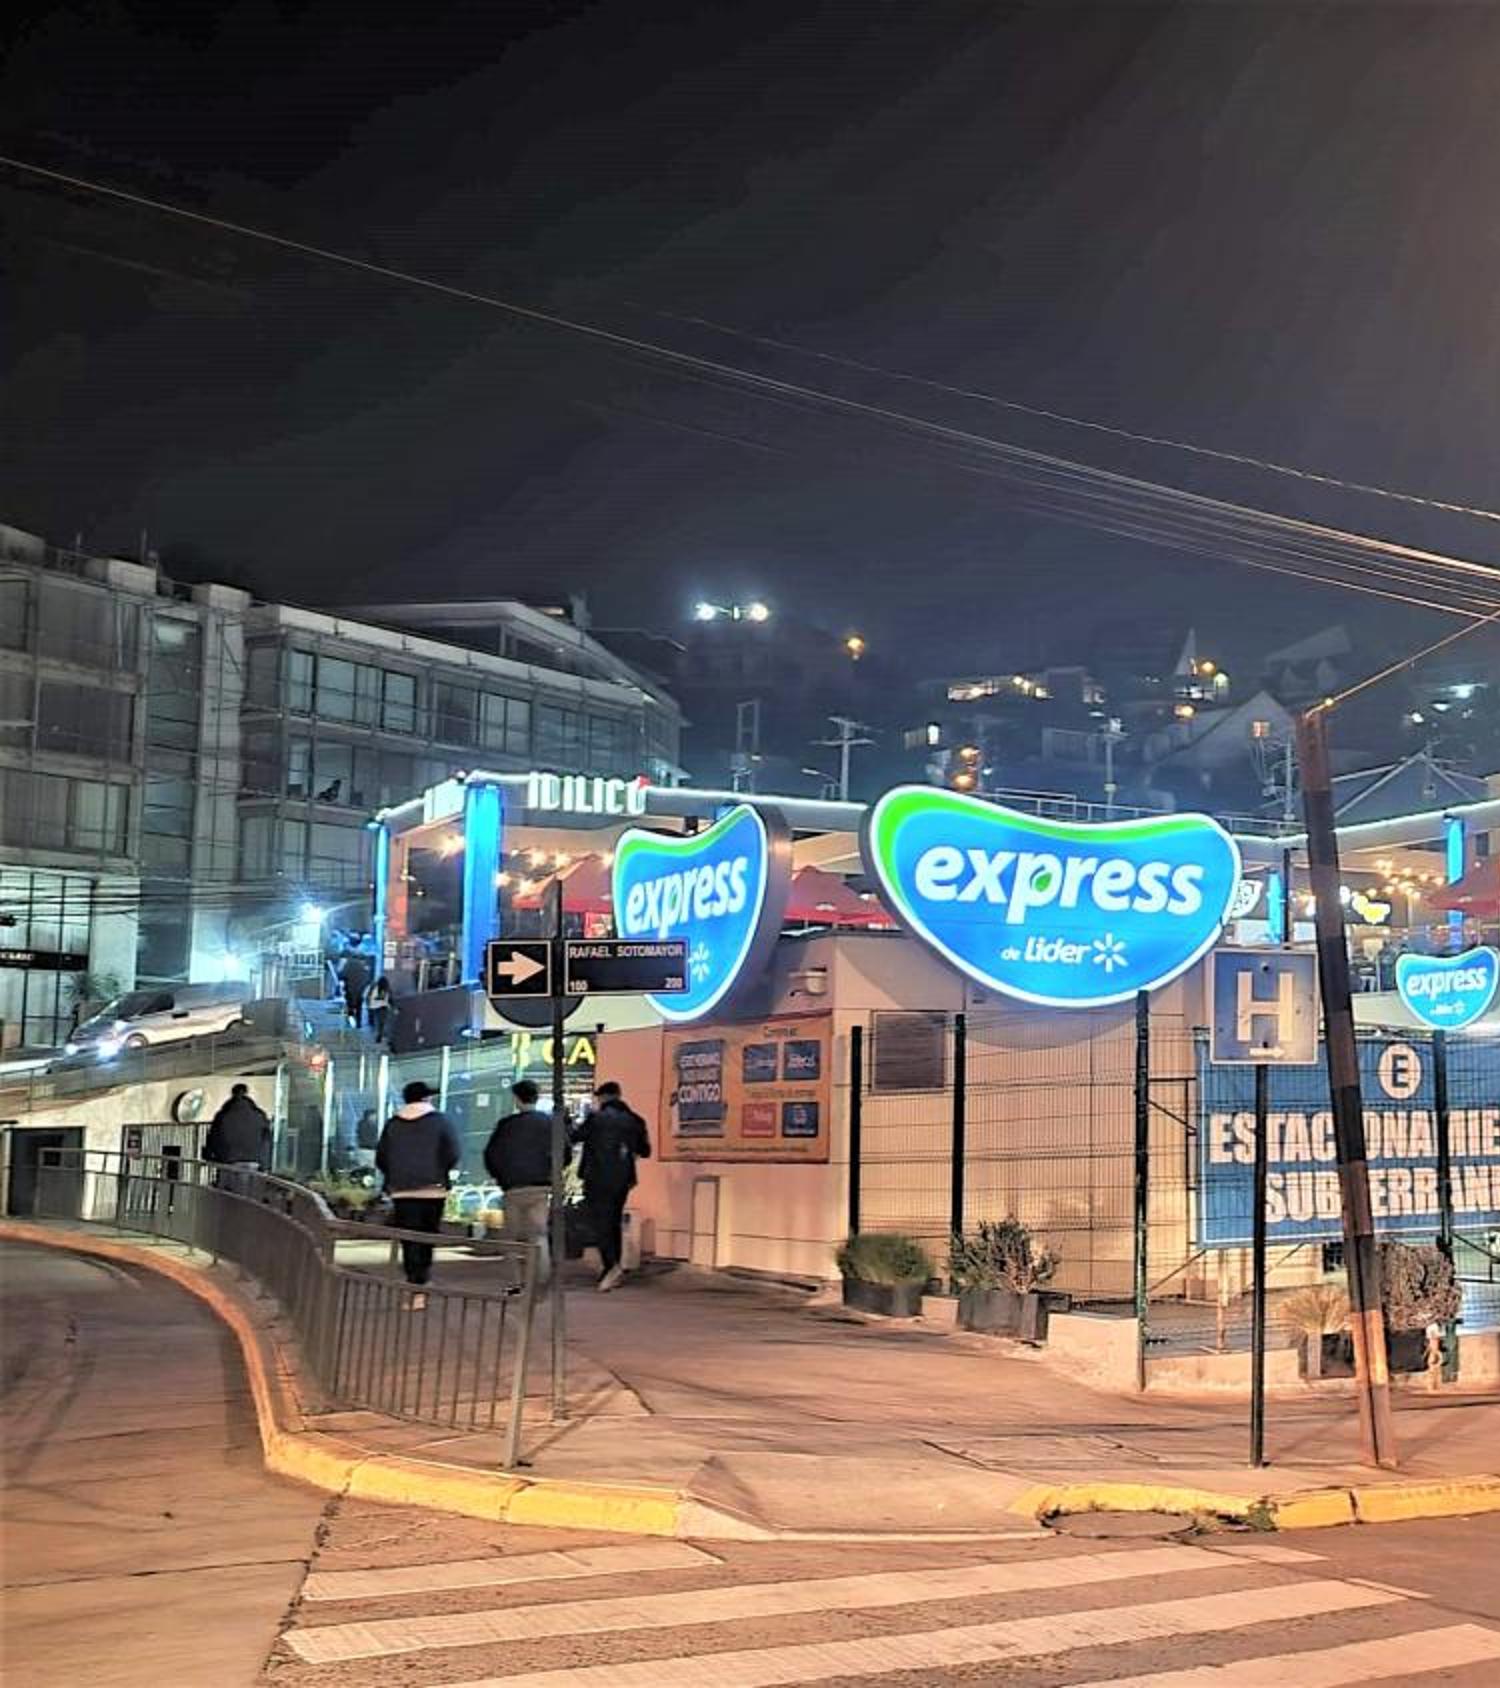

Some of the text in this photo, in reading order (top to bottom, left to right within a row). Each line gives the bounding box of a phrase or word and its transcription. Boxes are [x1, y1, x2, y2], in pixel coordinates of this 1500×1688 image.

[625, 855, 750, 939] express
[914, 845, 1206, 925] express
[569, 943, 684, 959] RAFAEL SOTOMAYOR
[1001, 935, 1091, 963] de Lider
[1237, 971, 1294, 1042] H
[1406, 966, 1487, 1001] express
